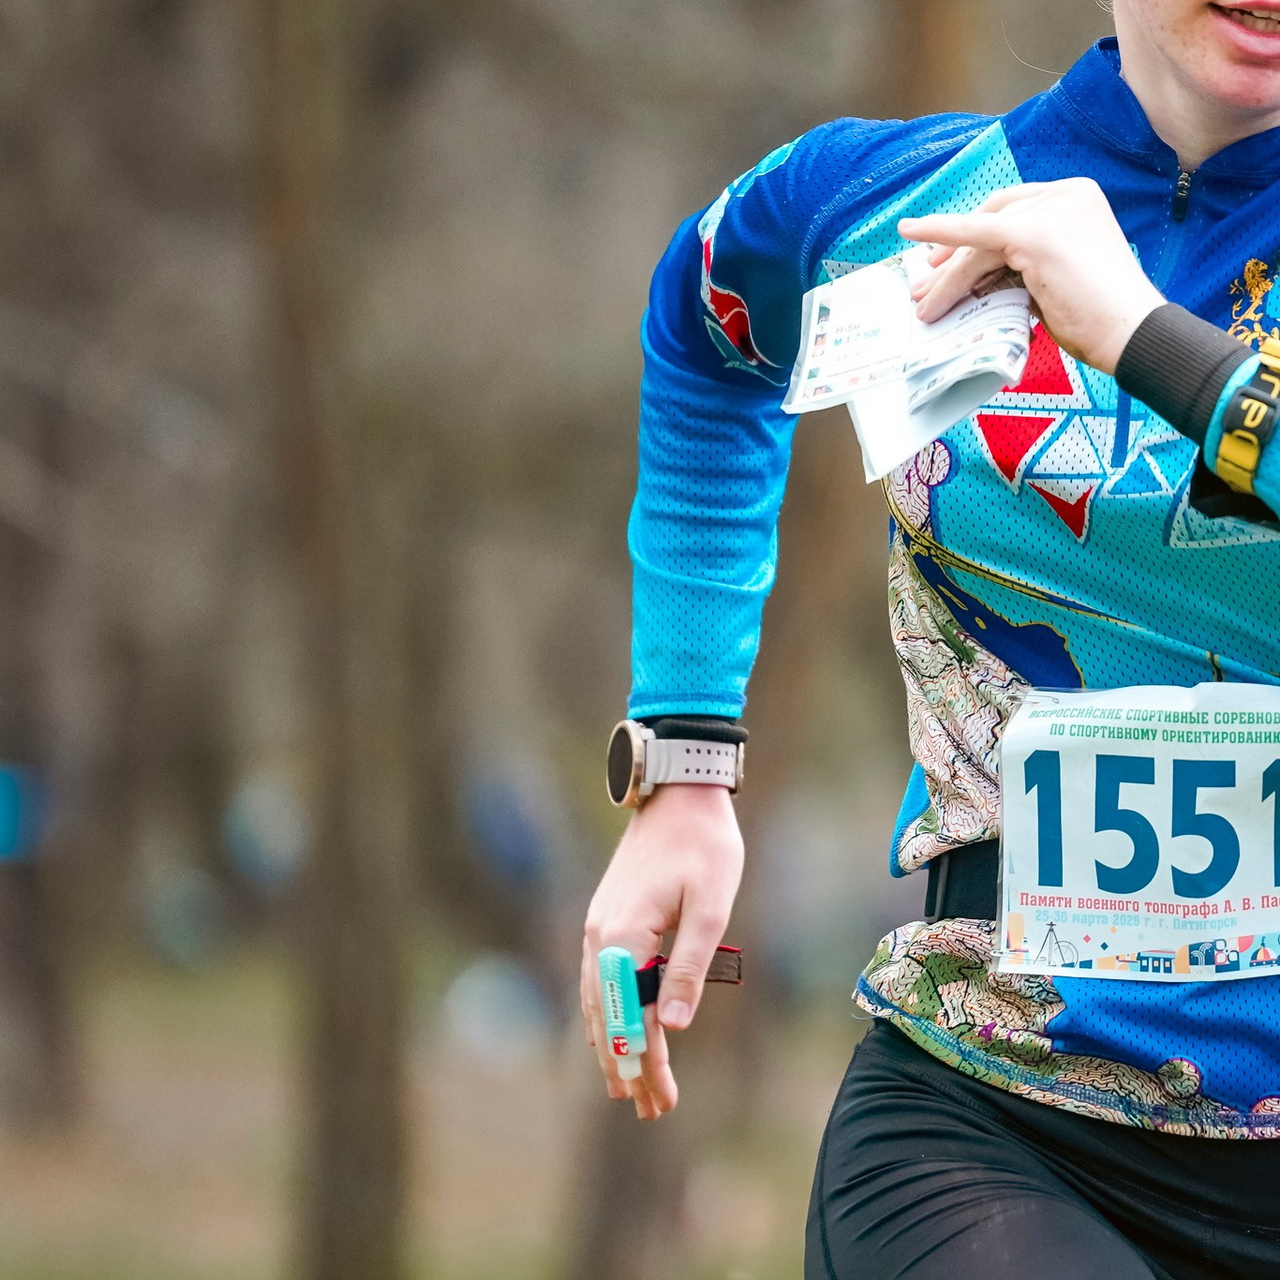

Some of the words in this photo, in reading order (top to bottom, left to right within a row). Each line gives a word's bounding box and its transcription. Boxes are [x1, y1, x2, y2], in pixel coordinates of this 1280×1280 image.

[1028, 706, 1123, 719] ВСЕРОССИЙСКИЕ
[1126, 709, 1209, 724] СПОРТИВНЫЕ
[1050, 723, 1065, 735] ПО
[1069, 724, 1158, 741] СПОРТИВНОМУ
[1020, 892, 1072, 908] Памяти
[1077, 897, 1140, 912] военного
[1144, 901, 1219, 919] топографа
[1223, 900, 1236, 913] А.
[1242, 898, 1255, 911] В.
[1035, 909, 1067, 922] 25-30
[1072, 914, 1108, 927] марта
[1144, 917, 1155, 928] г.
[1159, 918, 1169, 929] г.
[1173, 917, 1238, 932] Пятигорск
